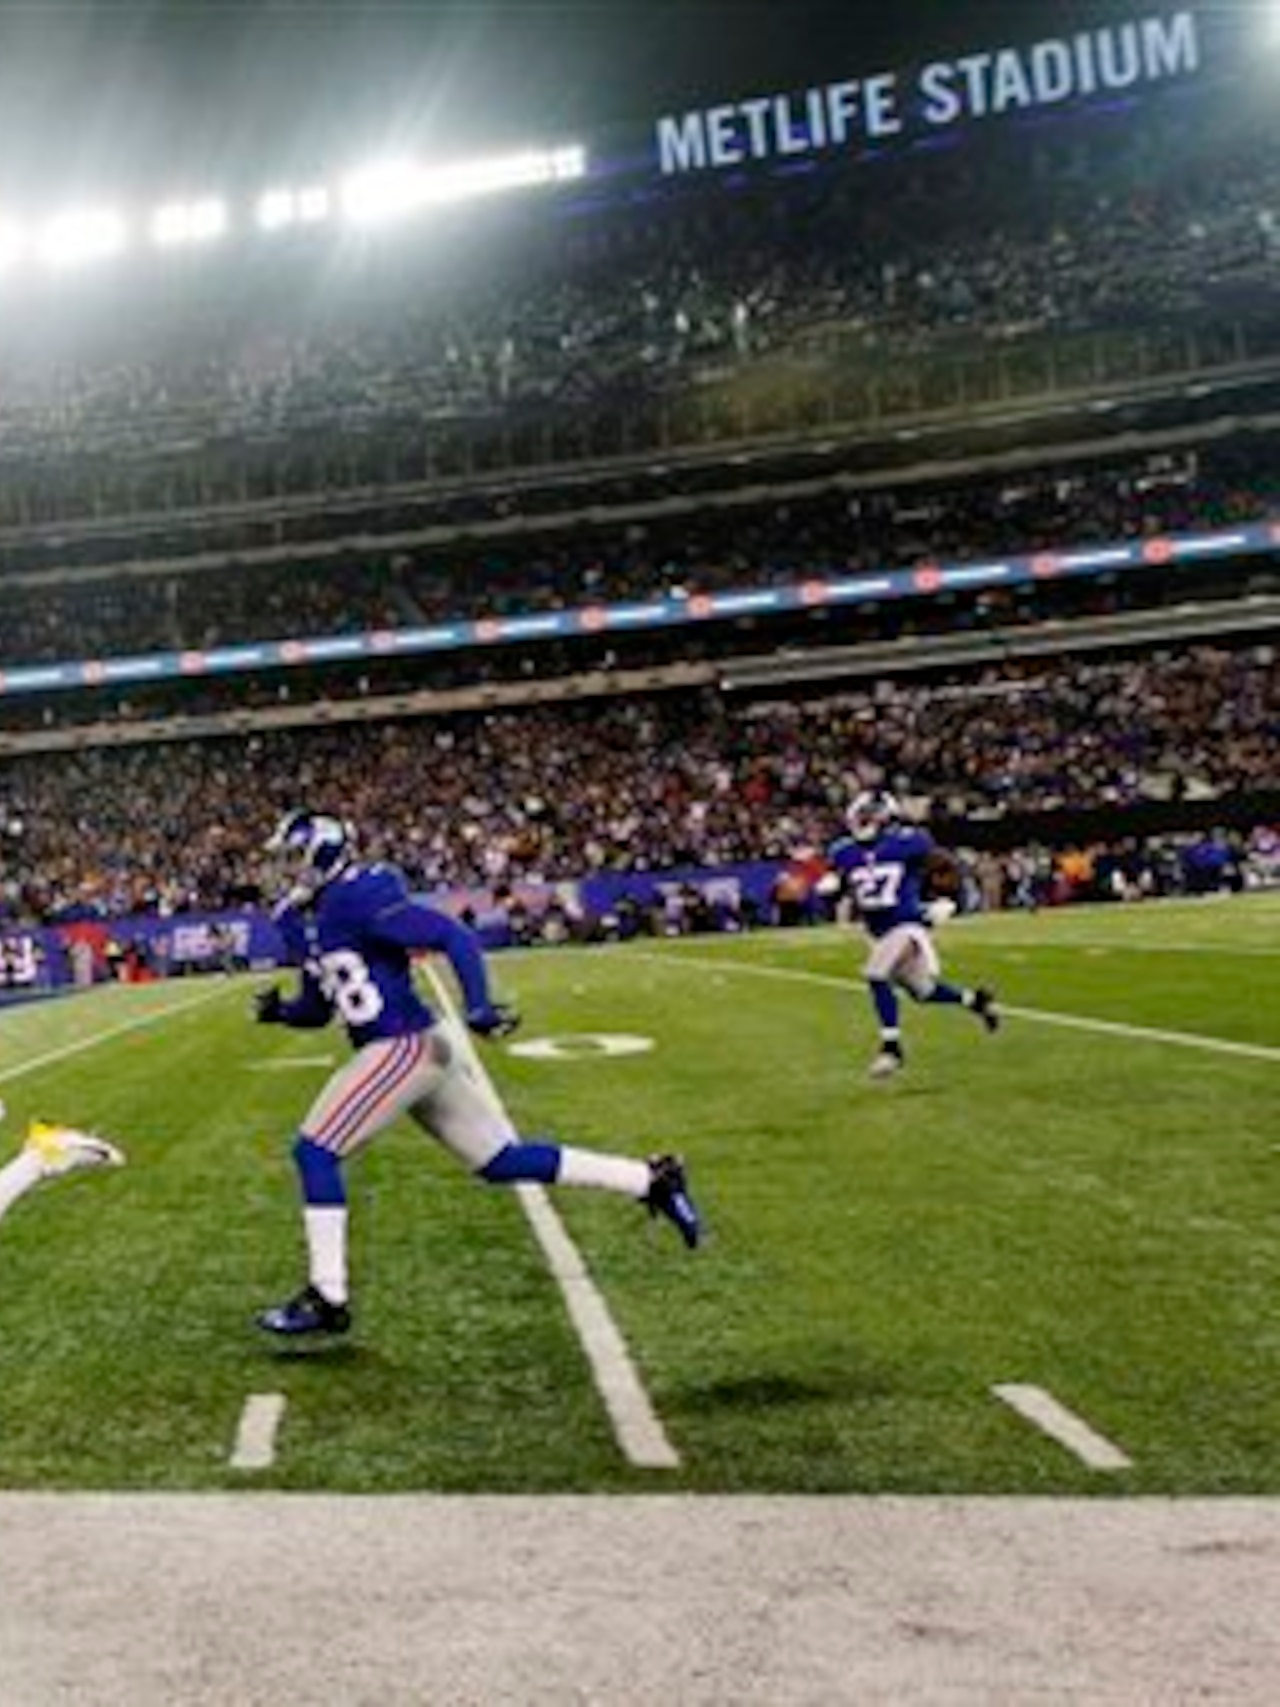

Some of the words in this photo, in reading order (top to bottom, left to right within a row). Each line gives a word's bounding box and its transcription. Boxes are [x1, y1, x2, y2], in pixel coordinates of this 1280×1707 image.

[657, 74, 901, 174] METLIFE
[920, 13, 1199, 124] STADIUM
[851, 860, 905, 910] 27
